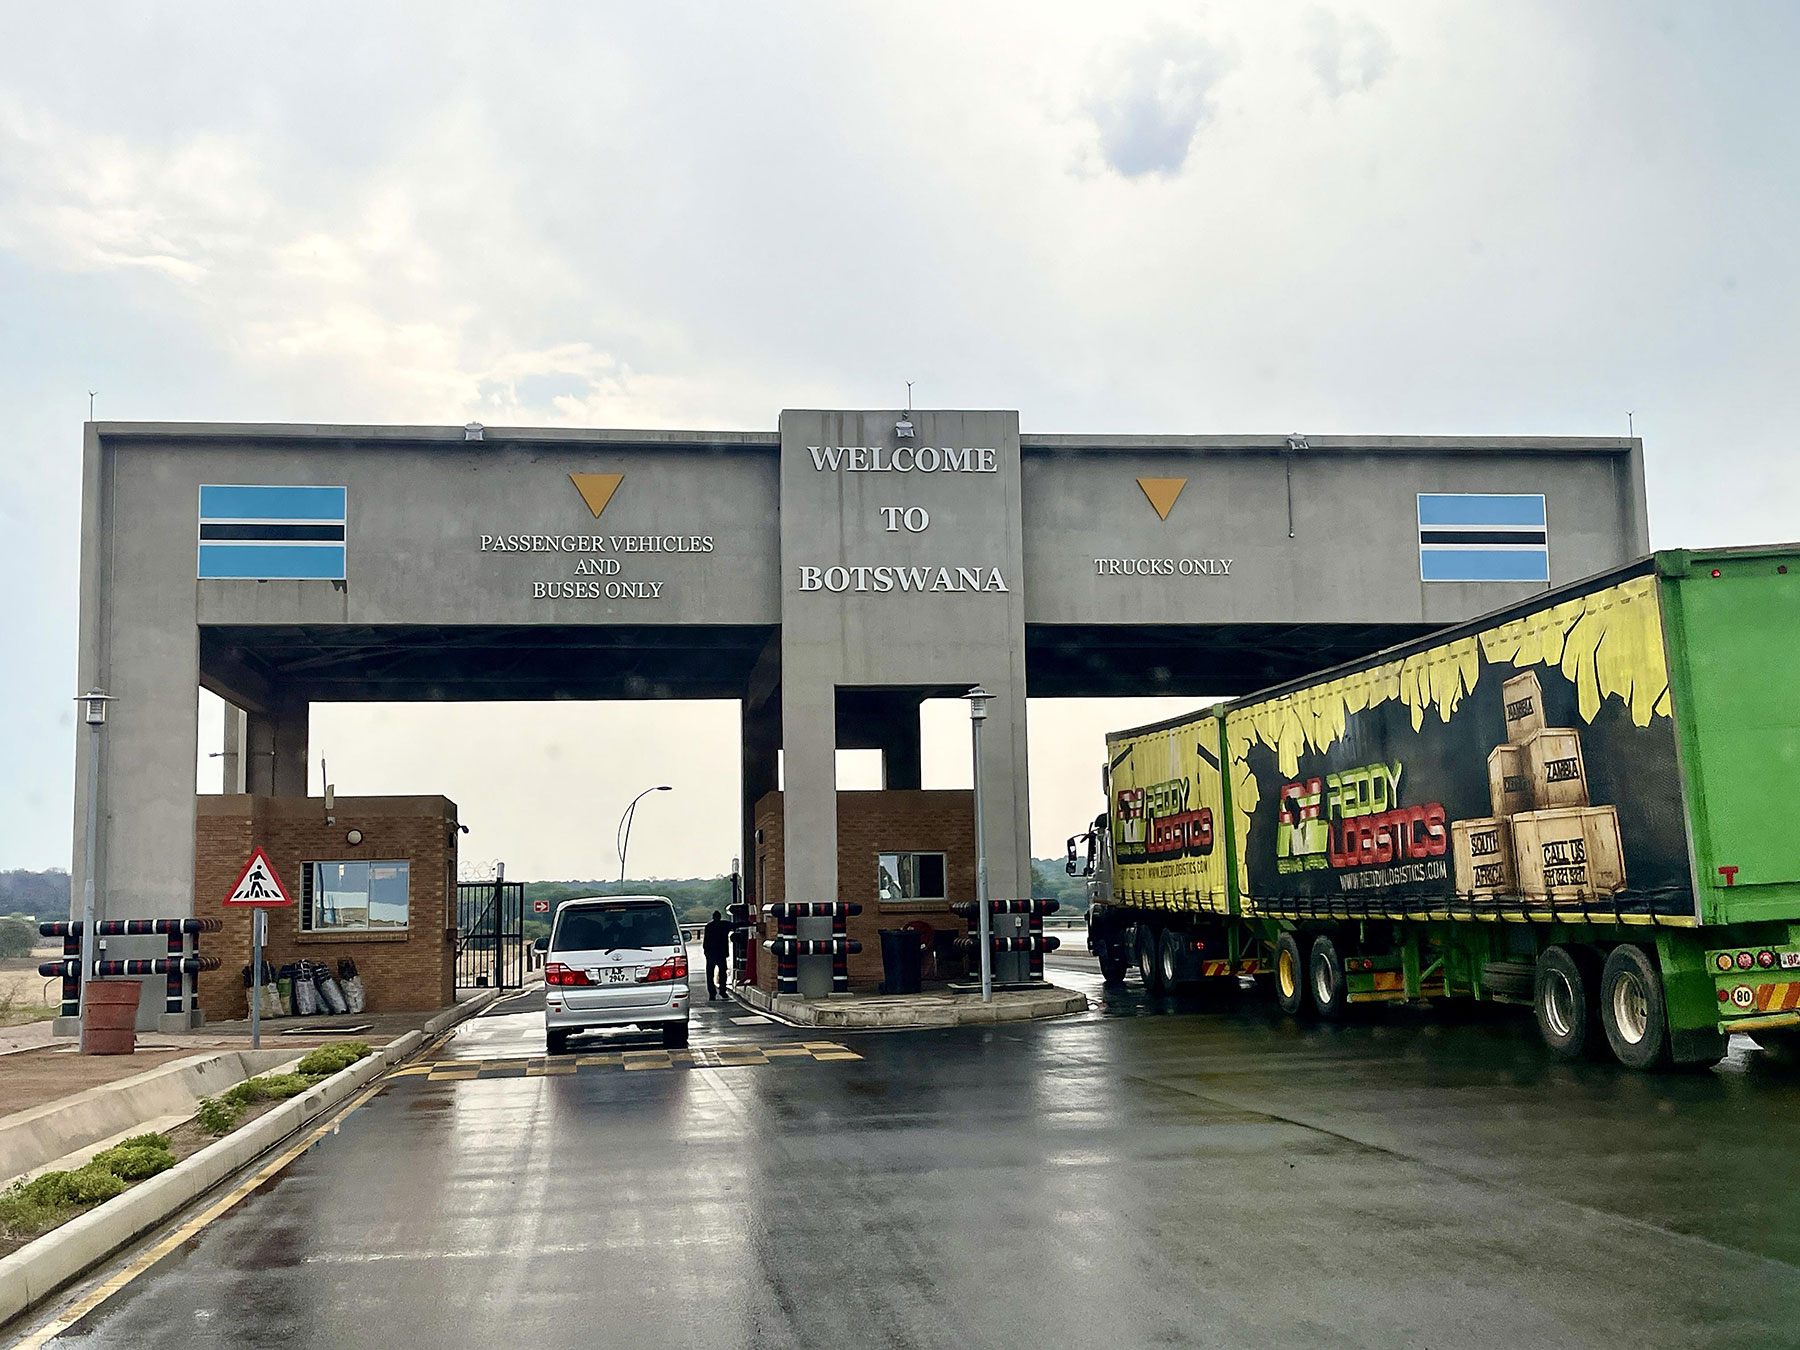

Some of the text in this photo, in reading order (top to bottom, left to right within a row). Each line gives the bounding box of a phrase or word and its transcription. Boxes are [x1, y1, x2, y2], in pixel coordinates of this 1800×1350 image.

[807, 446, 998, 472] WELCOME
[880, 506, 930, 532] TO
[480, 534, 714, 552] PASSENGER VEHICLES
[574, 558, 621, 575] AND
[798, 566, 1009, 592] BOTSWANA
[1094, 558, 1233, 575] TRUCKS ONLY
[533, 581, 664, 598] BUSES ONLY
[1328, 802, 1447, 868] LOGISTICS
[1470, 830, 1500, 856] SOUTH
[1542, 839, 1587, 866] CALL US
[1473, 862, 1505, 888] AFRICA
[1736, 989, 1751, 1003] 80
